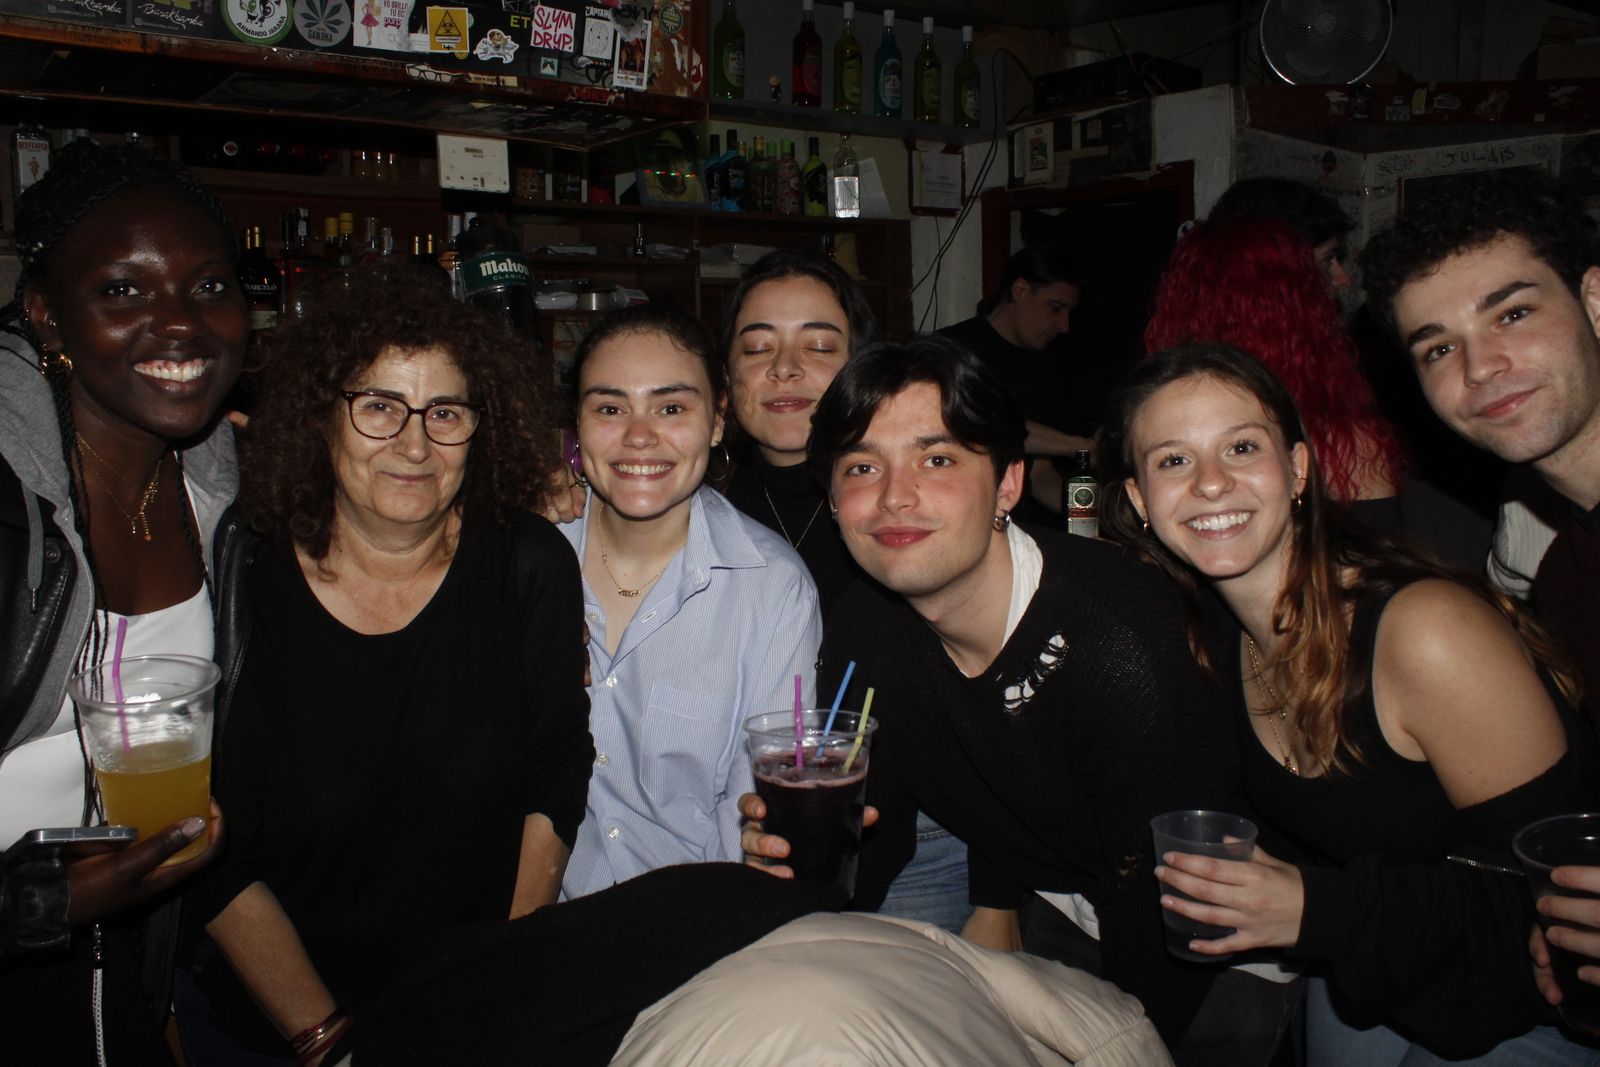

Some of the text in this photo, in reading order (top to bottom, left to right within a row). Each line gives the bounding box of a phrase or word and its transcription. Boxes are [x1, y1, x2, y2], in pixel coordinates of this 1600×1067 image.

[236, 16, 286, 37] ARMANDO JARANA
[534, 7, 573, 32] SLYM
[479, 257, 530, 277] Mahou
